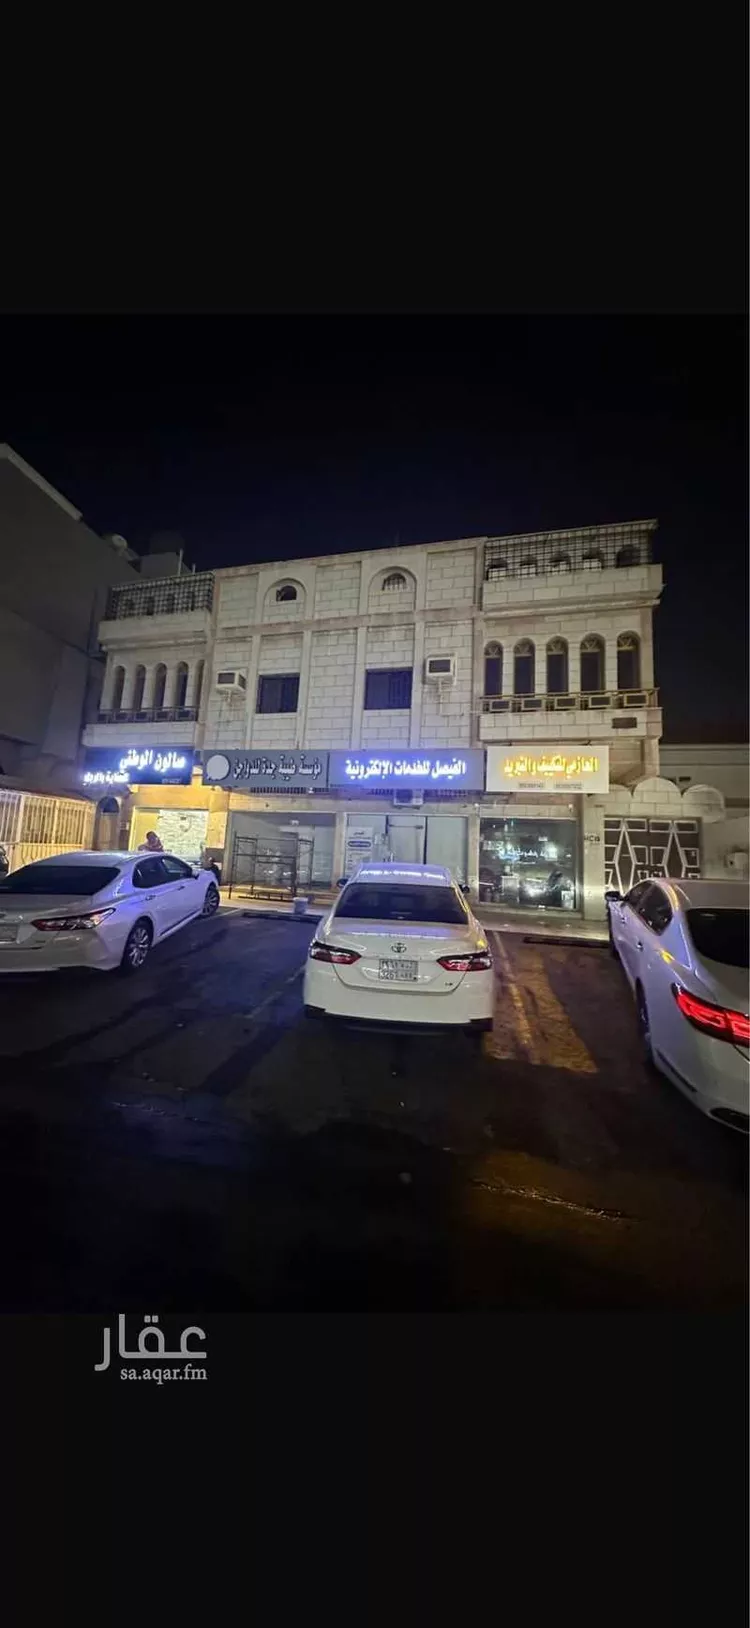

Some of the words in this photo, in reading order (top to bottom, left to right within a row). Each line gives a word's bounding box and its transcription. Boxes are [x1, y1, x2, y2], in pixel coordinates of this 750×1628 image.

[119, 748, 153, 774] الوطني
[153, 752, 186, 773] صالون
[394, 759, 431, 776] للخدمات
[431, 758, 466, 780] الفيصل
